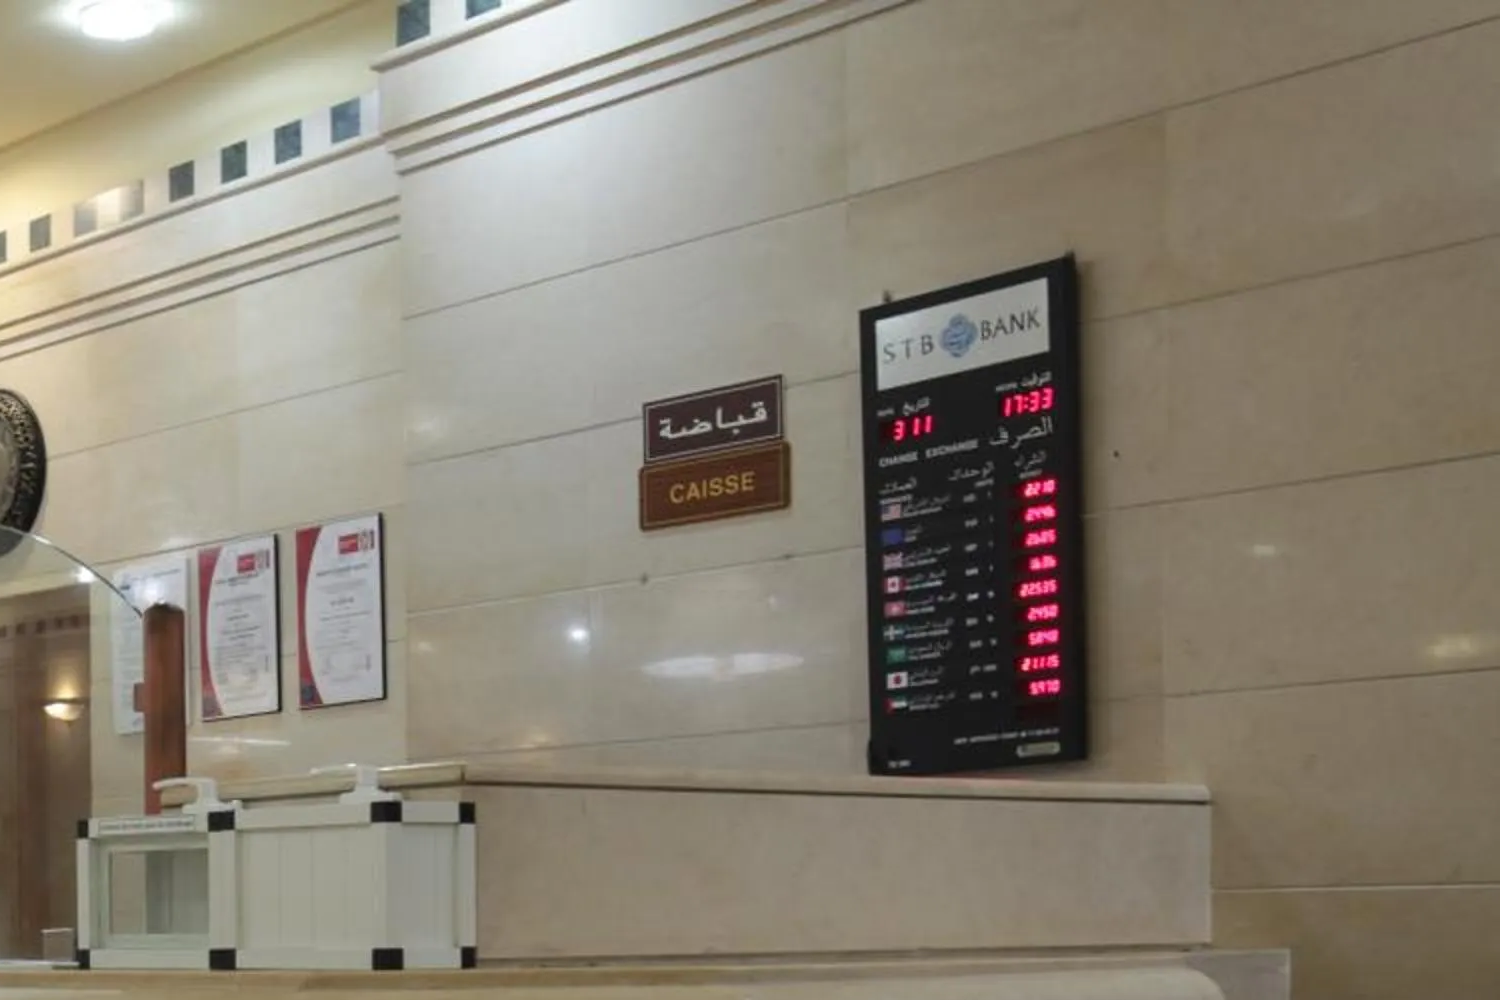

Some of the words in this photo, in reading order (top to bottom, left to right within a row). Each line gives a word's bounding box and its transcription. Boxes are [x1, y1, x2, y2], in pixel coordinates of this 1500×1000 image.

[980, 308, 1041, 341] BANK
[1004, 387, 1053, 417] 17:33
[659, 401, 768, 439] قباضة
[669, 470, 756, 504] CAISSE
